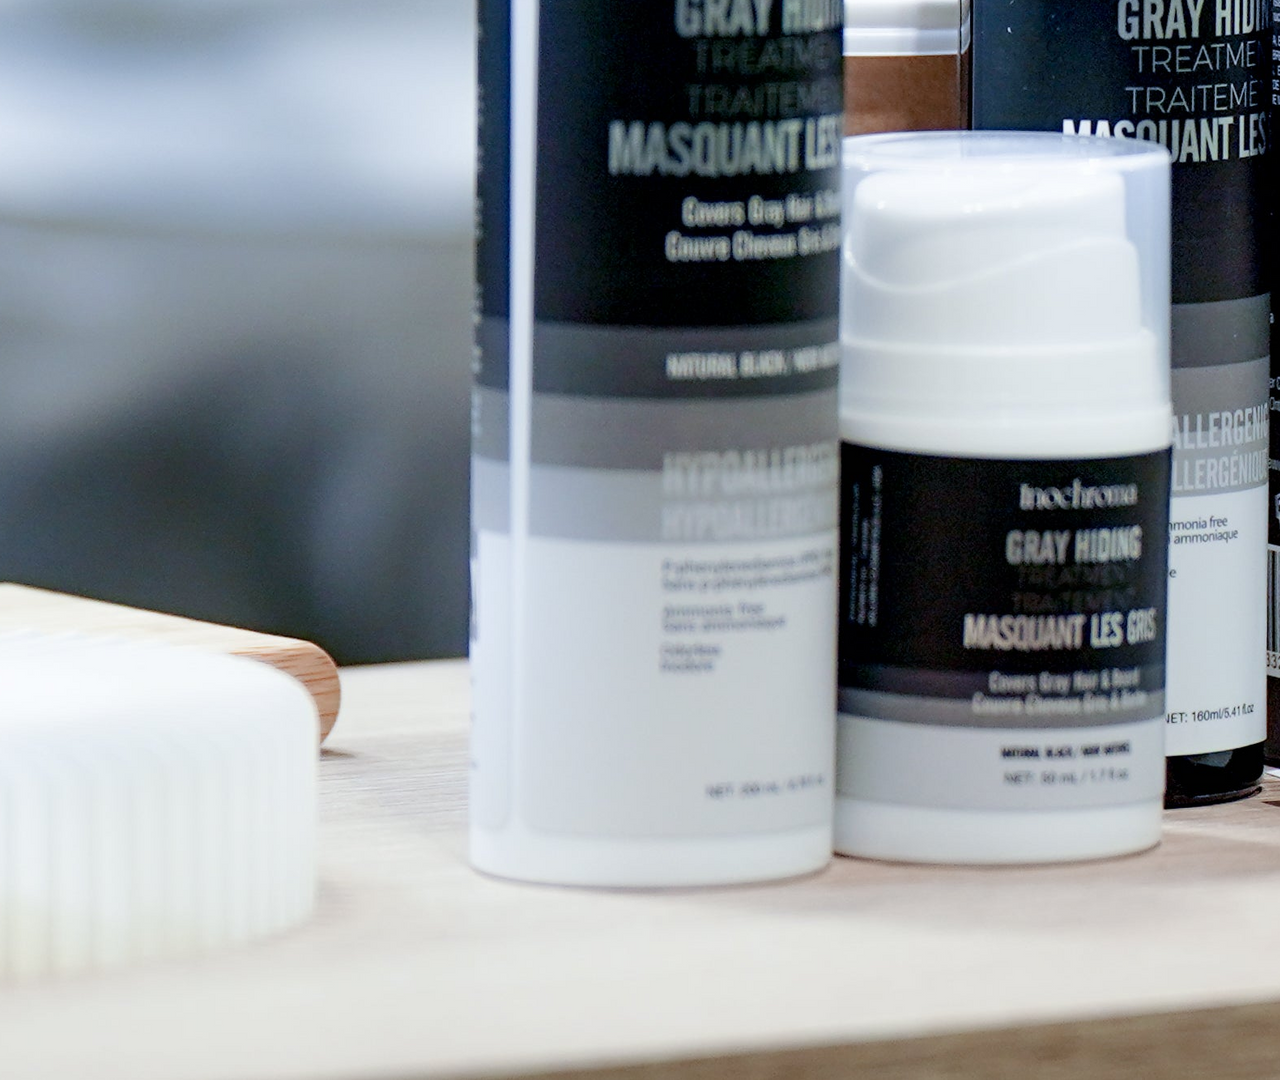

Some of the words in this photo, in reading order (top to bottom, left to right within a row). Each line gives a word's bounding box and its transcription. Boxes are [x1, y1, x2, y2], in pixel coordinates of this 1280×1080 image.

[1131, 40, 1256, 73] TREATME
[1125, 80, 1257, 114] TRAITEME
[608, 116, 802, 178] MASQUANT
[1239, 112, 1266, 158] LES
[1019, 478, 1138, 510] Inochroma
[1169, 515, 1208, 531] mmonia
[1209, 514, 1228, 529] free
[1174, 528, 1238, 547] ammoniaque
[1005, 529, 1071, 565] GRAY
[1074, 525, 1141, 562] HIDING
[963, 613, 1085, 651] MASQUANT
[1090, 610, 1123, 649] LES
[1126, 607, 1157, 645] GRIS
